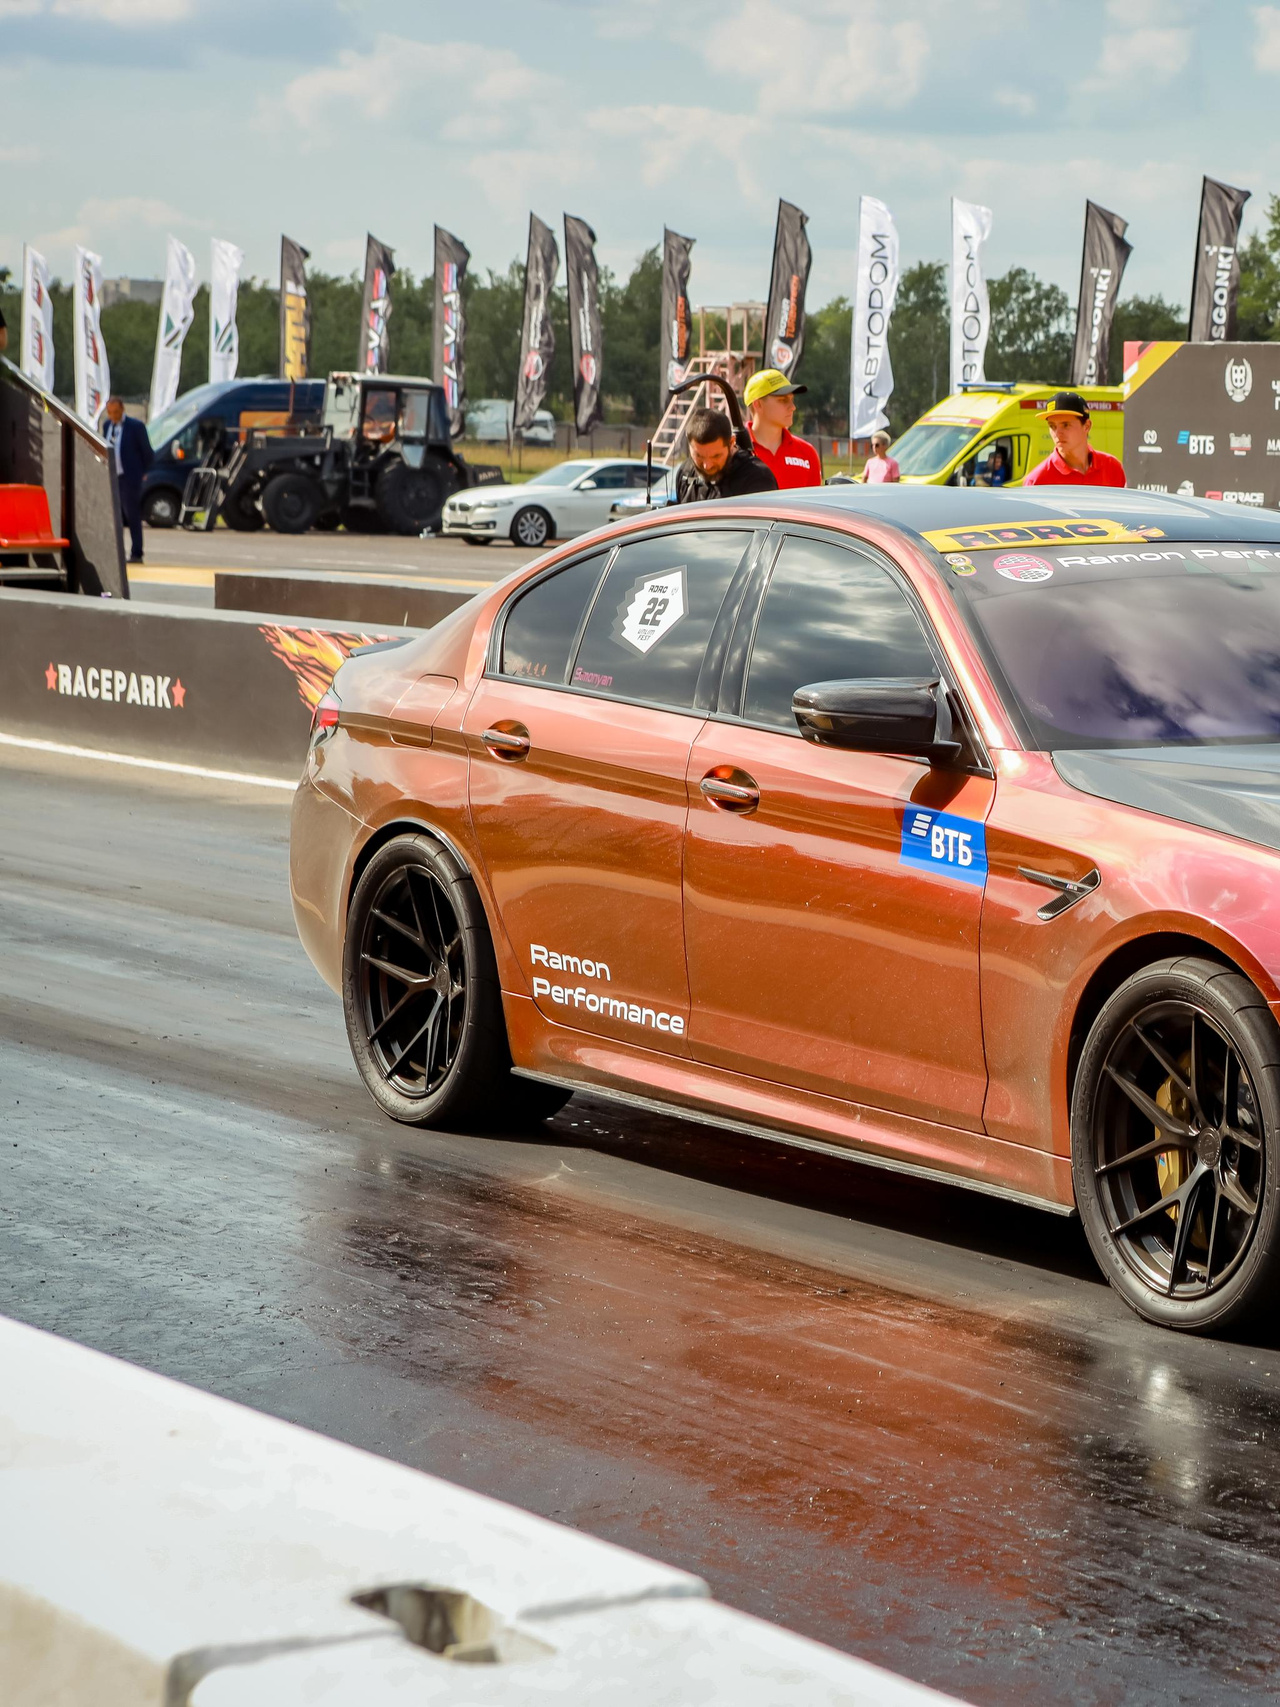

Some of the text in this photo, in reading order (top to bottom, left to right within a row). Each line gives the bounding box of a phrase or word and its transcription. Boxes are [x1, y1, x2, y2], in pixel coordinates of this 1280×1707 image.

[1211, 246, 1235, 341] SGONKI
[1189, 435, 1215, 455] ВТБ
[946, 523, 1109, 548] RDRC
[1057, 550, 1185, 568] Ramon
[639, 597, 669, 626] 22
[57, 663, 172, 709] RACEPARK
[930, 824, 972, 867] ВТБ
[530, 943, 611, 981] Ramon
[532, 976, 685, 1036] Performance
